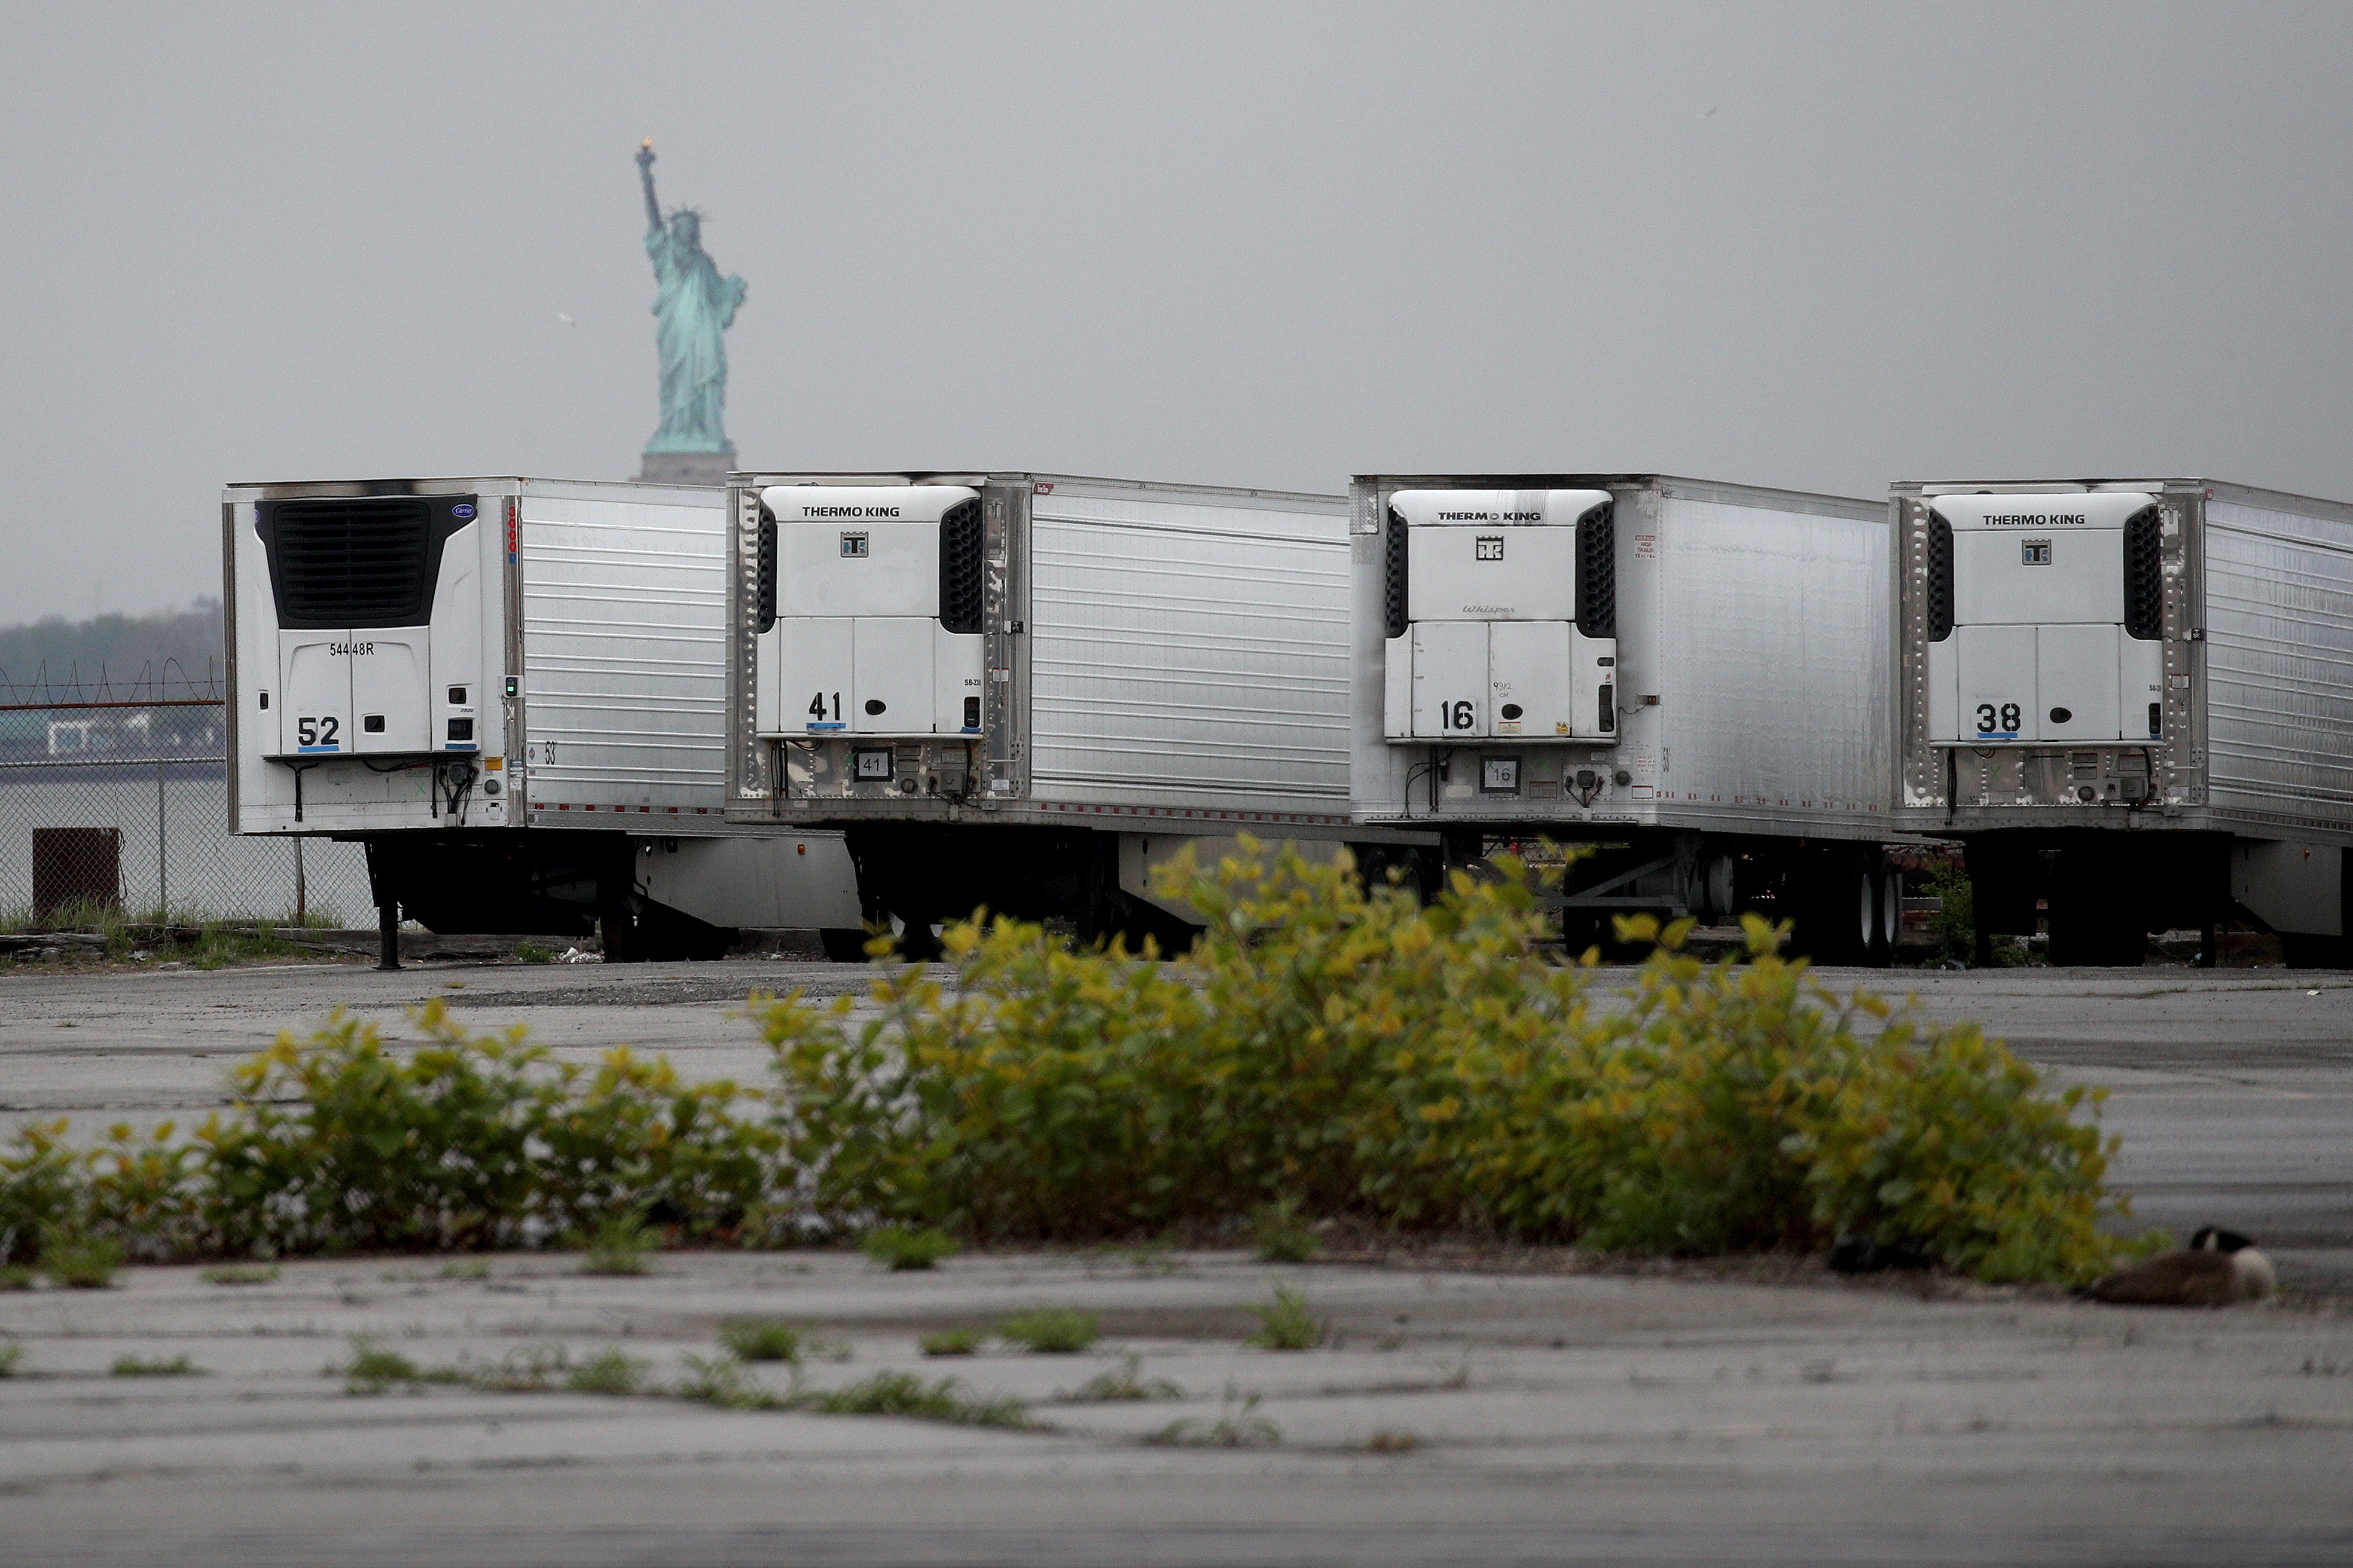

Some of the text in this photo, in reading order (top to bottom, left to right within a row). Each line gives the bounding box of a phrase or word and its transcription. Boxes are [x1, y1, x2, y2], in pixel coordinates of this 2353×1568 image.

[802, 507, 900, 516] THERMO KING
[1503, 512, 1541, 521] KING
[1983, 514, 2085, 525] THERMO KING
[1463, 605, 1515, 615] Whisper
[330, 643, 374, 656] 54448R
[809, 692, 840, 721] 41
[1442, 701, 1473, 729] 16
[1977, 703, 2021, 733] 38
[298, 717, 339, 745] 52
[863, 759, 879, 771] 41
[1494, 768, 1510, 781] 16
